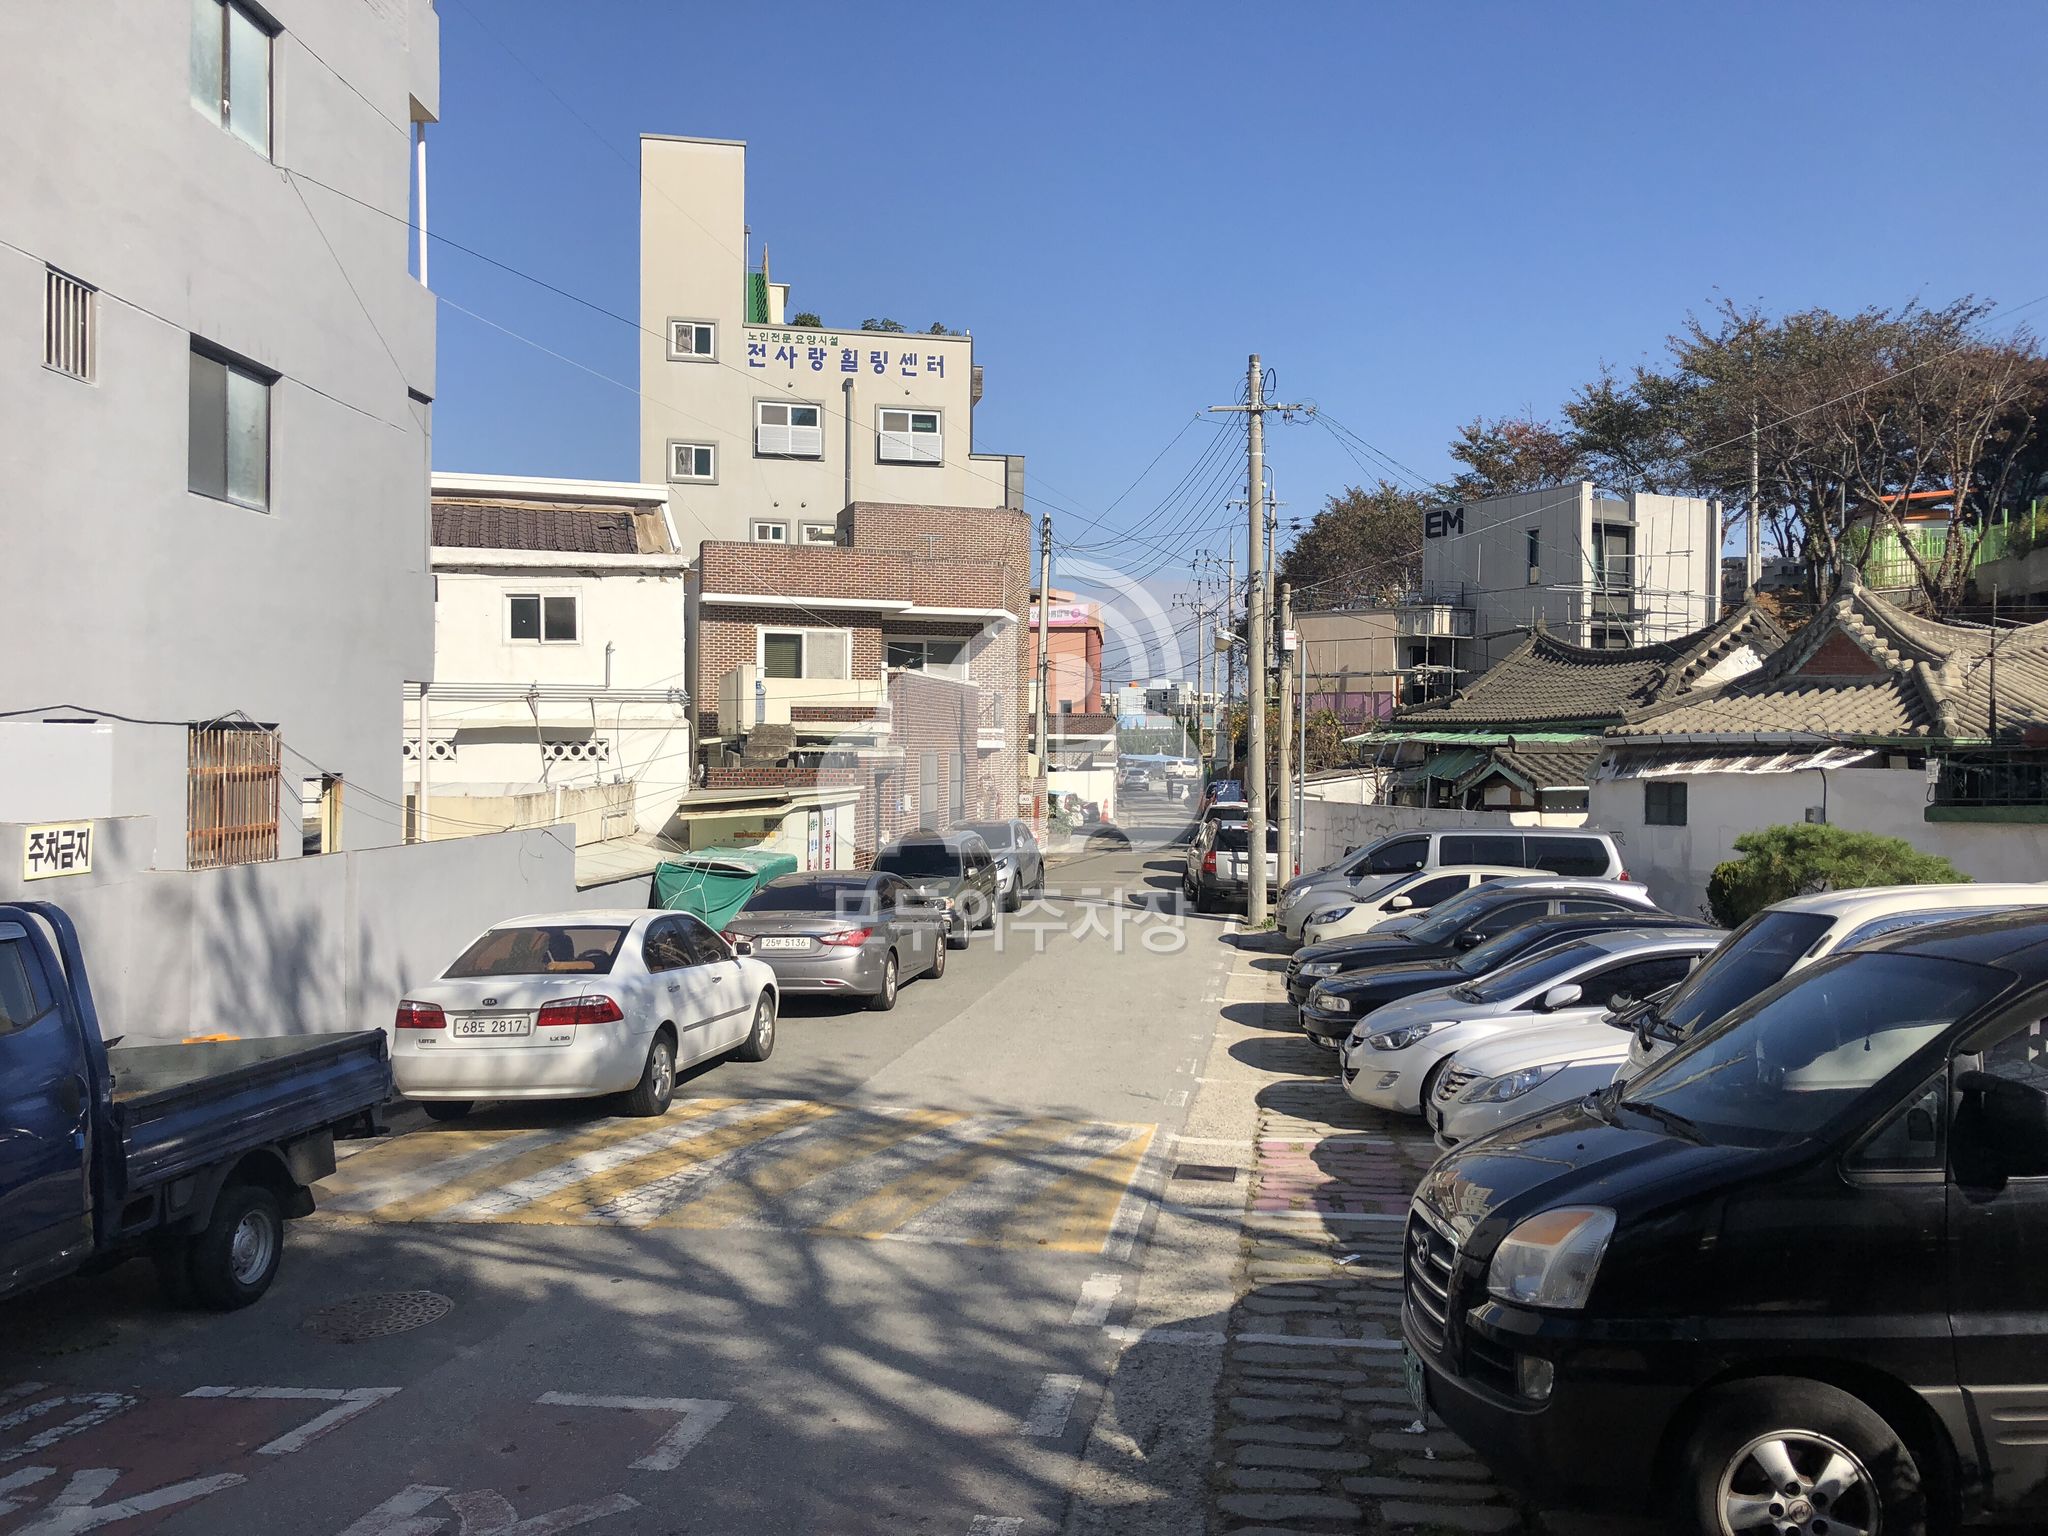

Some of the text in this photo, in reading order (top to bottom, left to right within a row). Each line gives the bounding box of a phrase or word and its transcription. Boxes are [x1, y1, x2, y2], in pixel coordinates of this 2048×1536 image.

[747, 331, 839, 347] 노인전문 요양시설
[1425, 507, 1464, 539] EM
[28, 828, 91, 873] 주차금지
[785, 938, 806, 947] 5136
[483, 998, 498, 1006] KIA
[462, 1020, 522, 1033] 68도 2817
